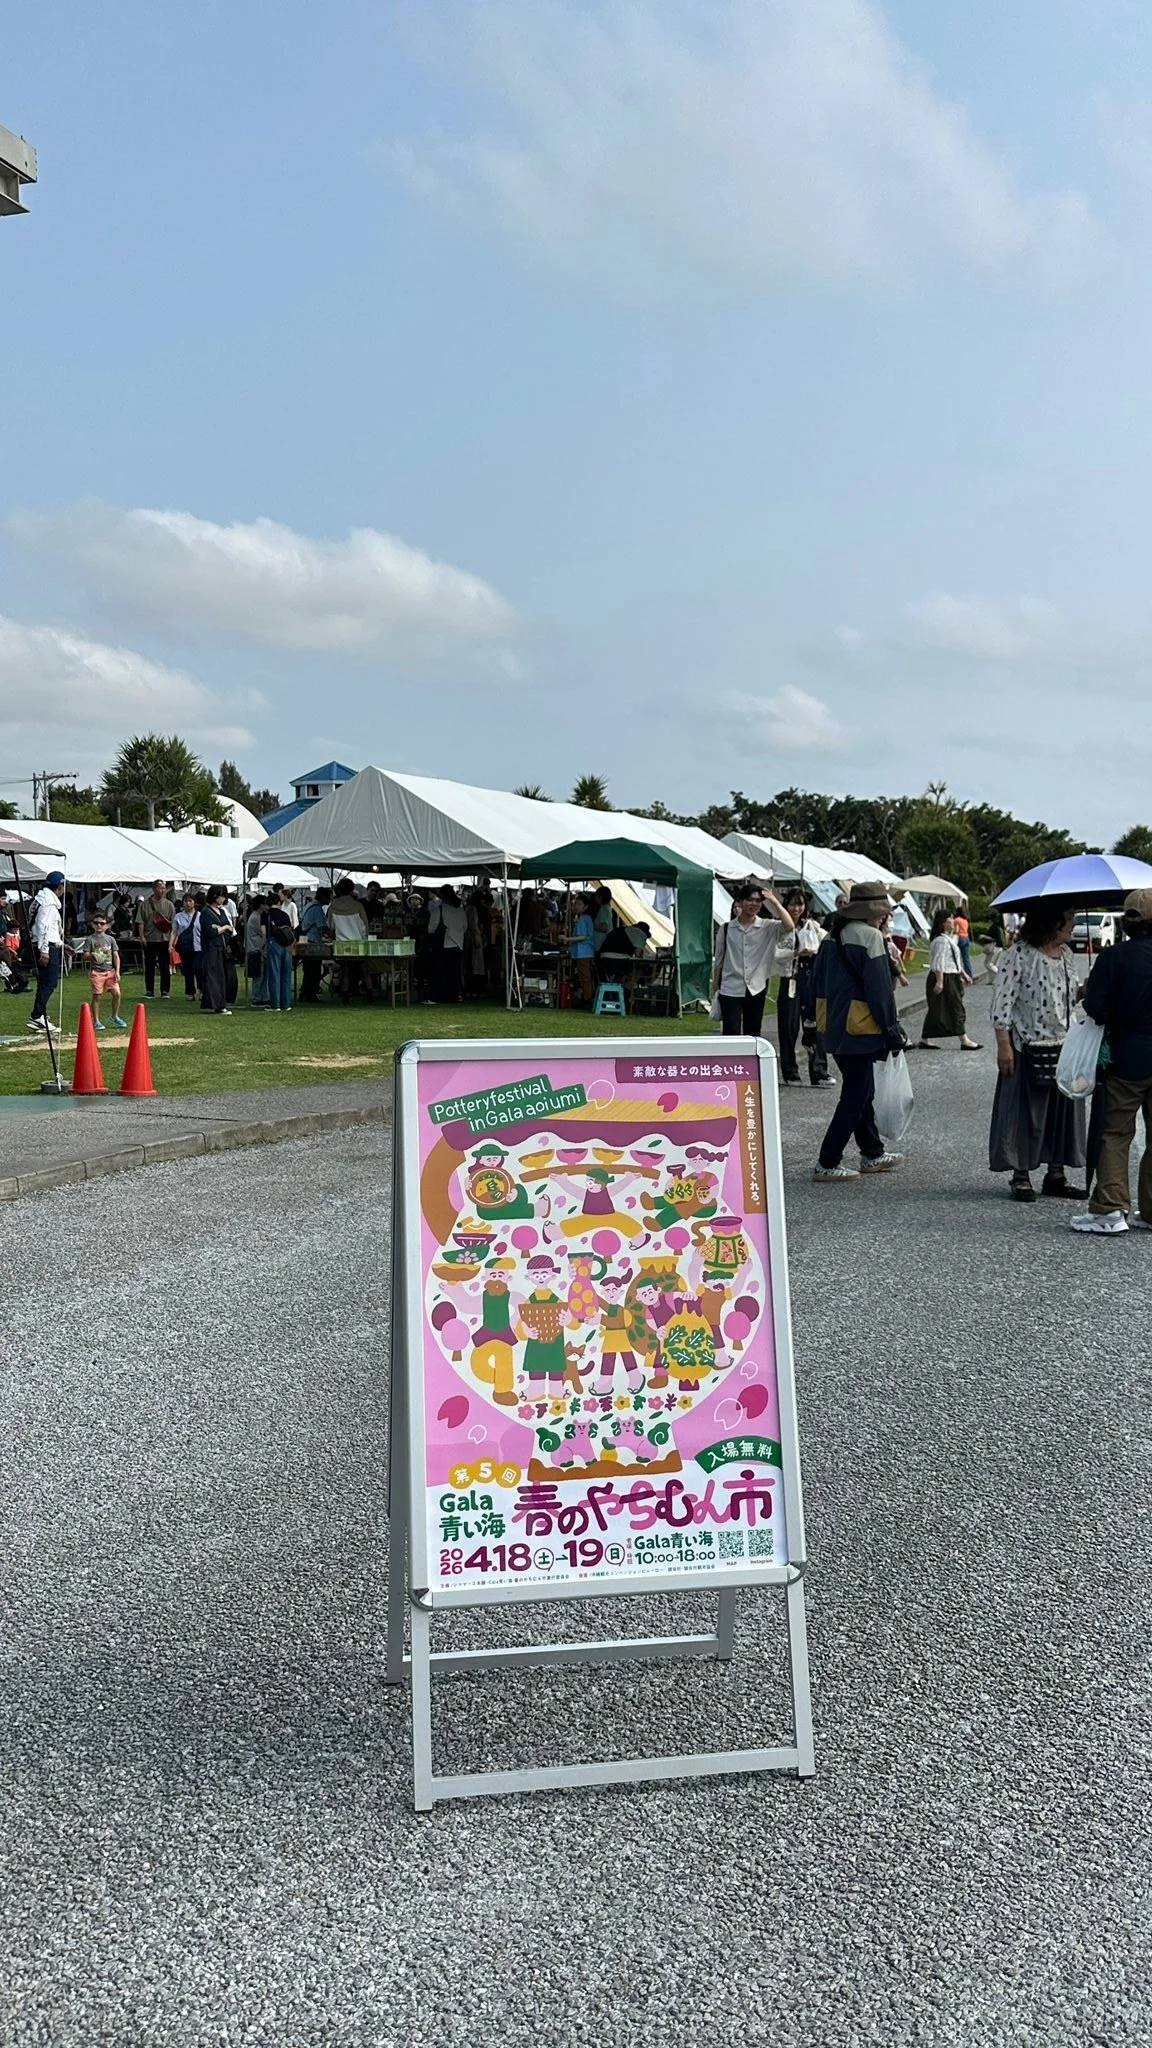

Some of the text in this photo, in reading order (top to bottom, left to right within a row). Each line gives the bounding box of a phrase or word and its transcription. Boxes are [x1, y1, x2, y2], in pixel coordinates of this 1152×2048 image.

[633, 1064, 750, 1077] 素敵な器との出会いは、
[744, 1084, 760, 1206] 人生を豊かにしてくれる。
[707, 1440, 773, 1468] 入場無料
[454, 1462, 517, 1485] 第5回
[439, 1490, 494, 1513] Gala
[511, 1469, 776, 1536] 春のやちむん市
[439, 1512, 506, 1542] 青い海
[634, 1530, 714, 1549] Gala青い海
